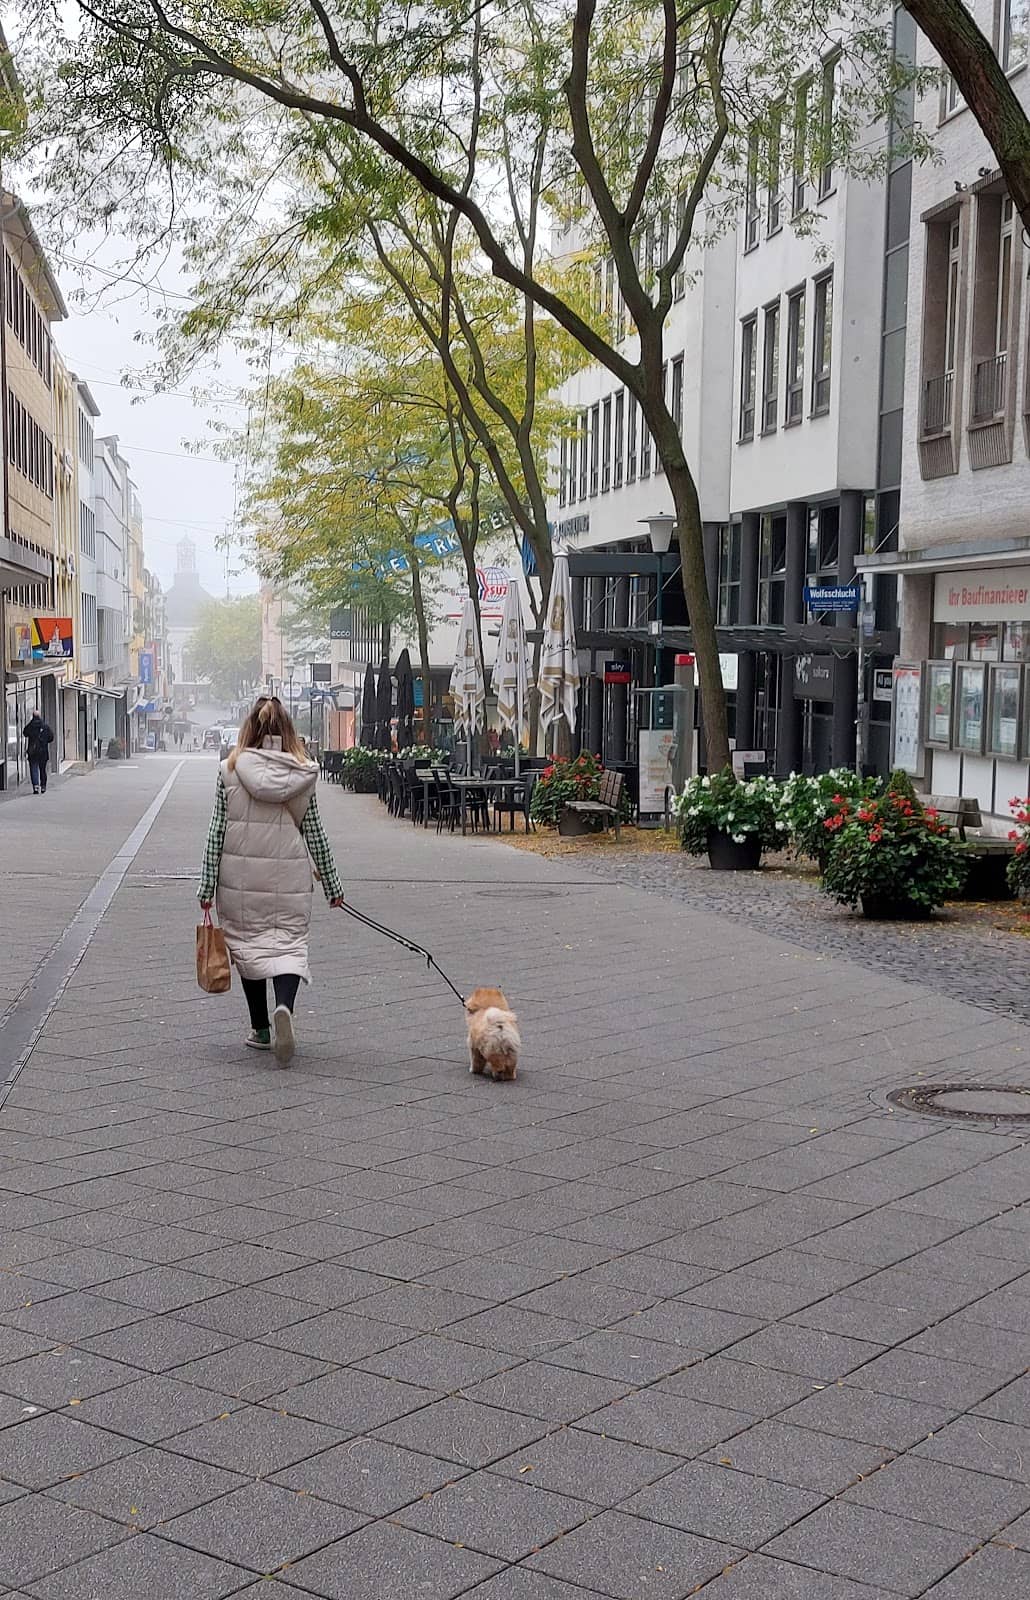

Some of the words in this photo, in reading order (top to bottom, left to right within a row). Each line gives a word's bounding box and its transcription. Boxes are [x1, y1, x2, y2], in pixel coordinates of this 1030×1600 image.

[810, 588, 856, 598] Wolfsschlucht
[948, 588, 960, 606] Ihr
[961, 586, 1028, 605] Baufinanzierer
[611, 663, 624, 673] sky
